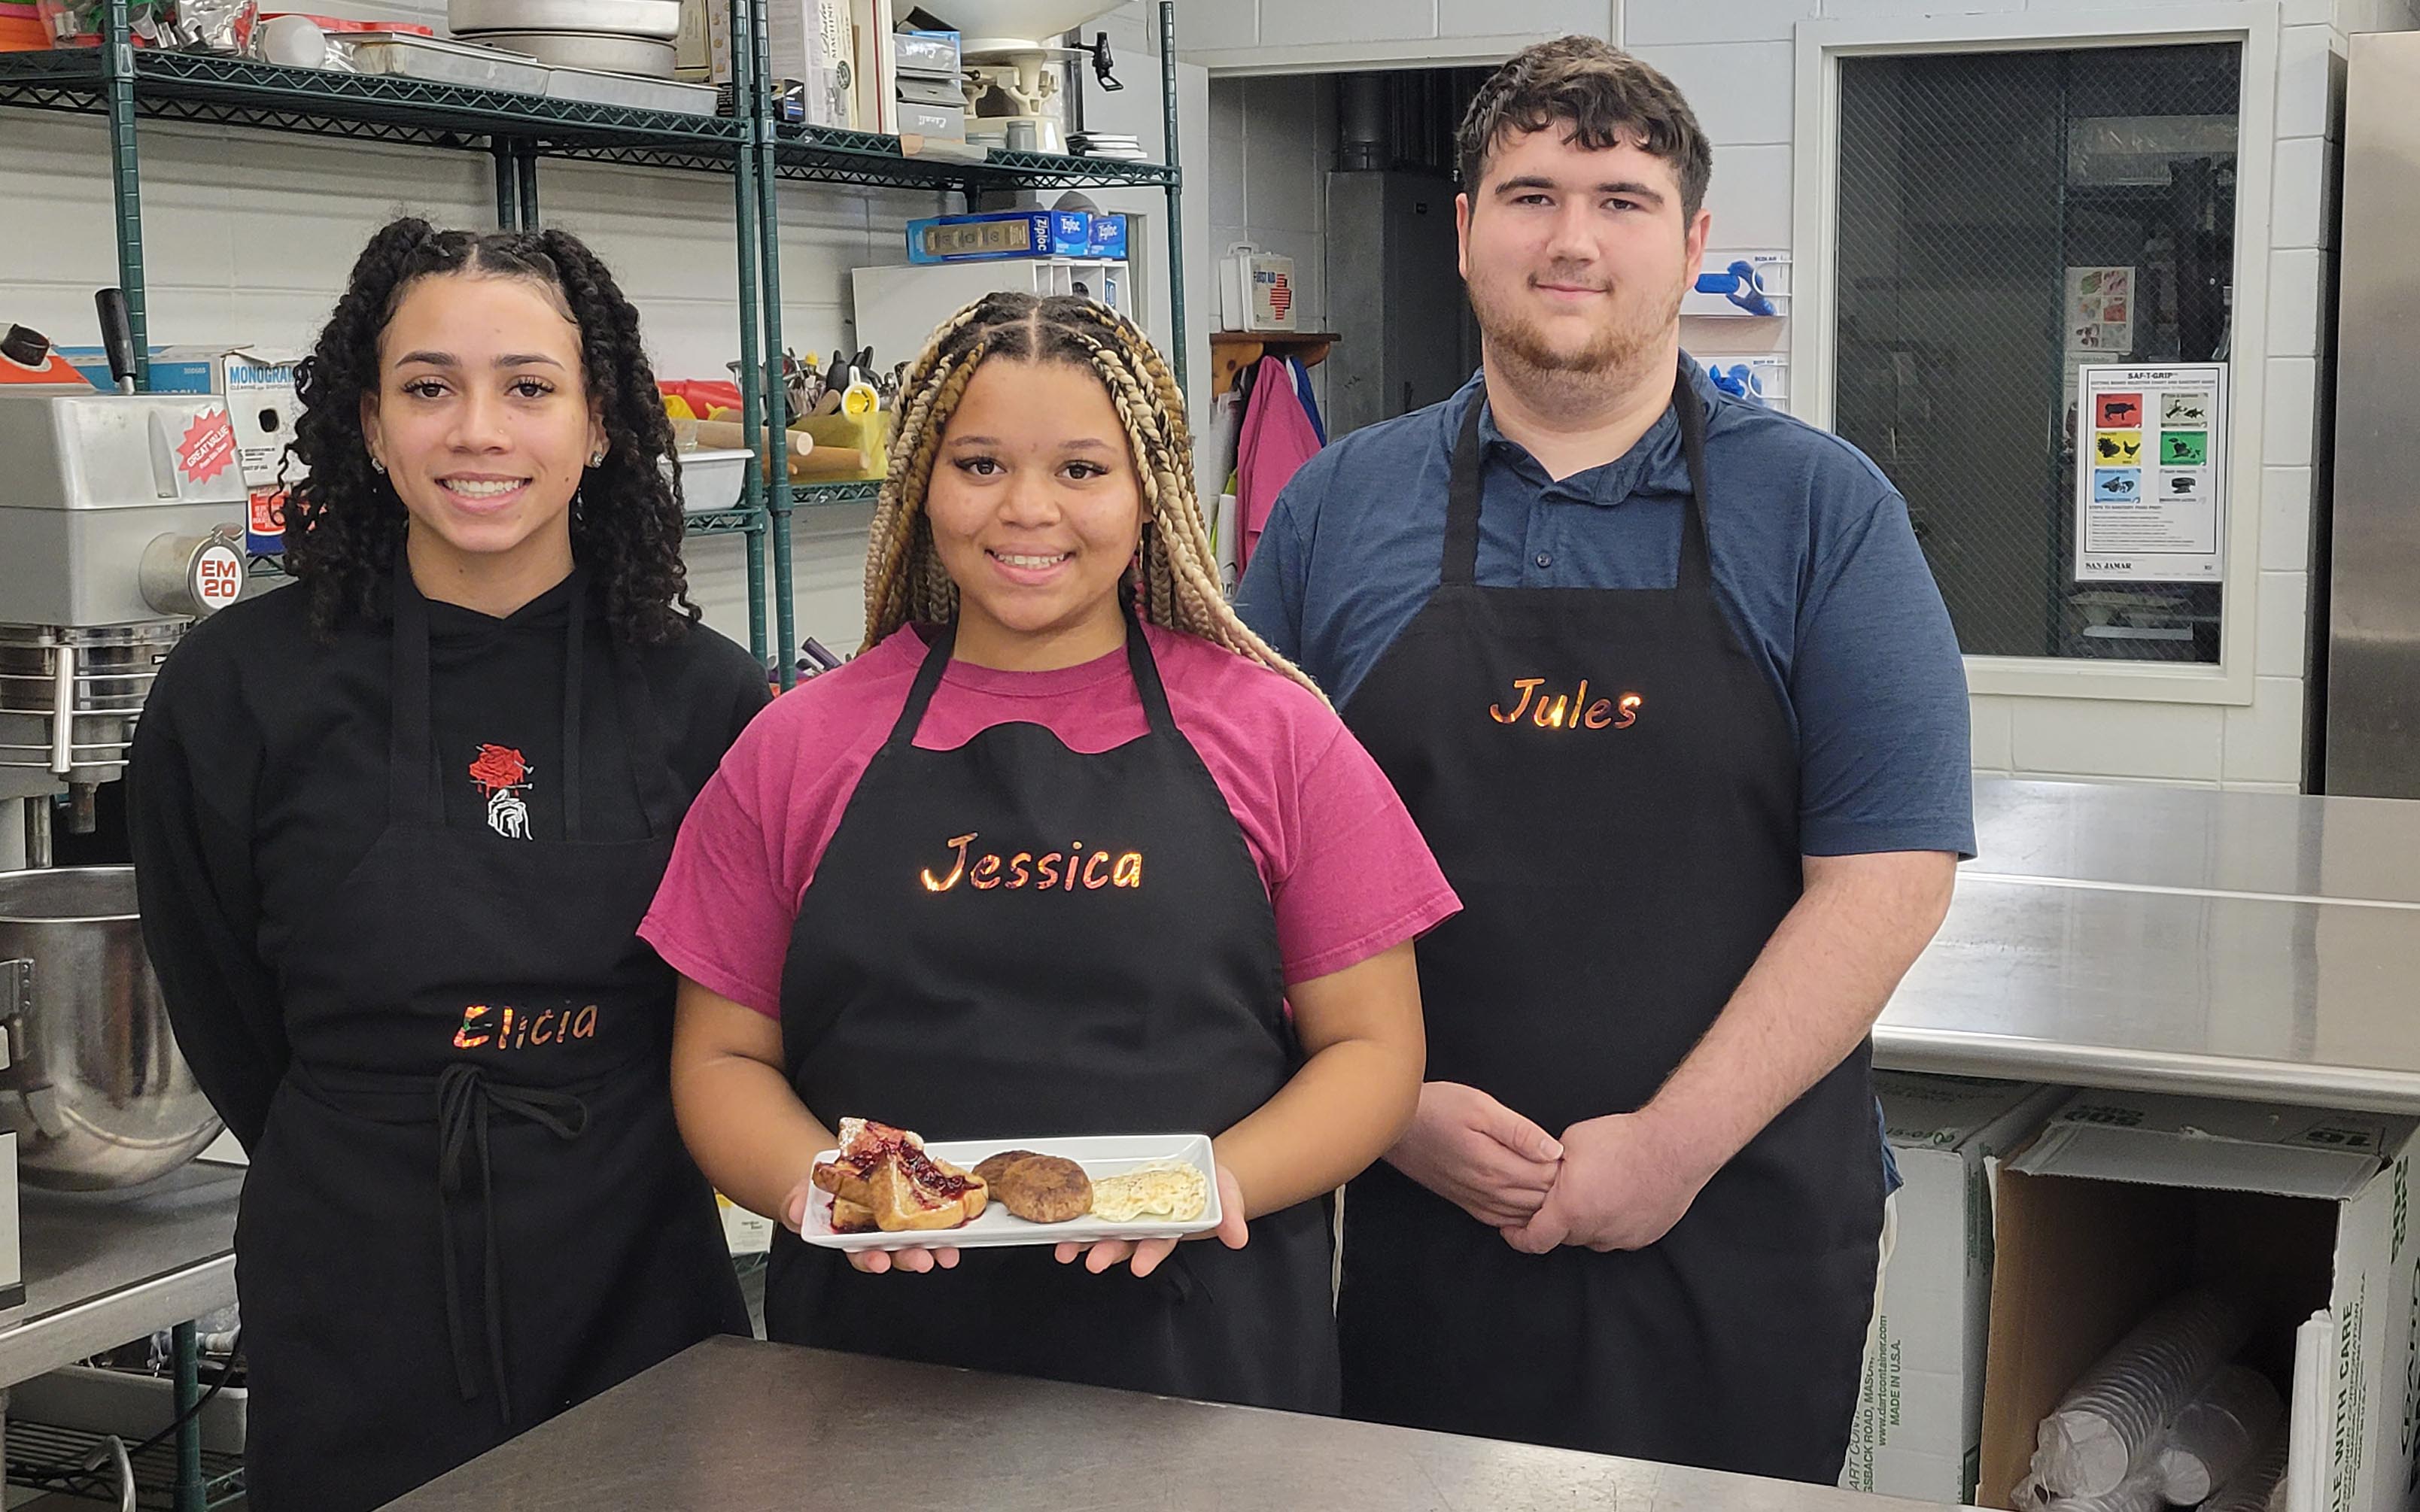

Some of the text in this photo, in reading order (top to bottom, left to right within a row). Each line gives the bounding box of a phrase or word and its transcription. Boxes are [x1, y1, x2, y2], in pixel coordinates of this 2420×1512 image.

[1036, 217, 1047, 252] Ziploc
[1060, 217, 1081, 234] Ziploc
[1099, 223, 1117, 241] Ziploc
[187, 443, 210, 467] GREAT
[206, 424, 229, 448] VALUE
[202, 560, 236, 578] EM
[204, 578, 236, 597] 20
[1490, 679, 1642, 729] Jules
[920, 831, 1142, 892] Jessica
[453, 1000, 599, 1050] Elicia
[2339, 1301, 2353, 1380] CARE
[1877, 1315, 1887, 1446] www.dartcontainer.com
[1890, 1339, 1901, 1425] MADE IN U.S.A.
[1863, 1407, 1874, 1444] ROAD,
[2334, 1388, 2347, 1468] WITH
